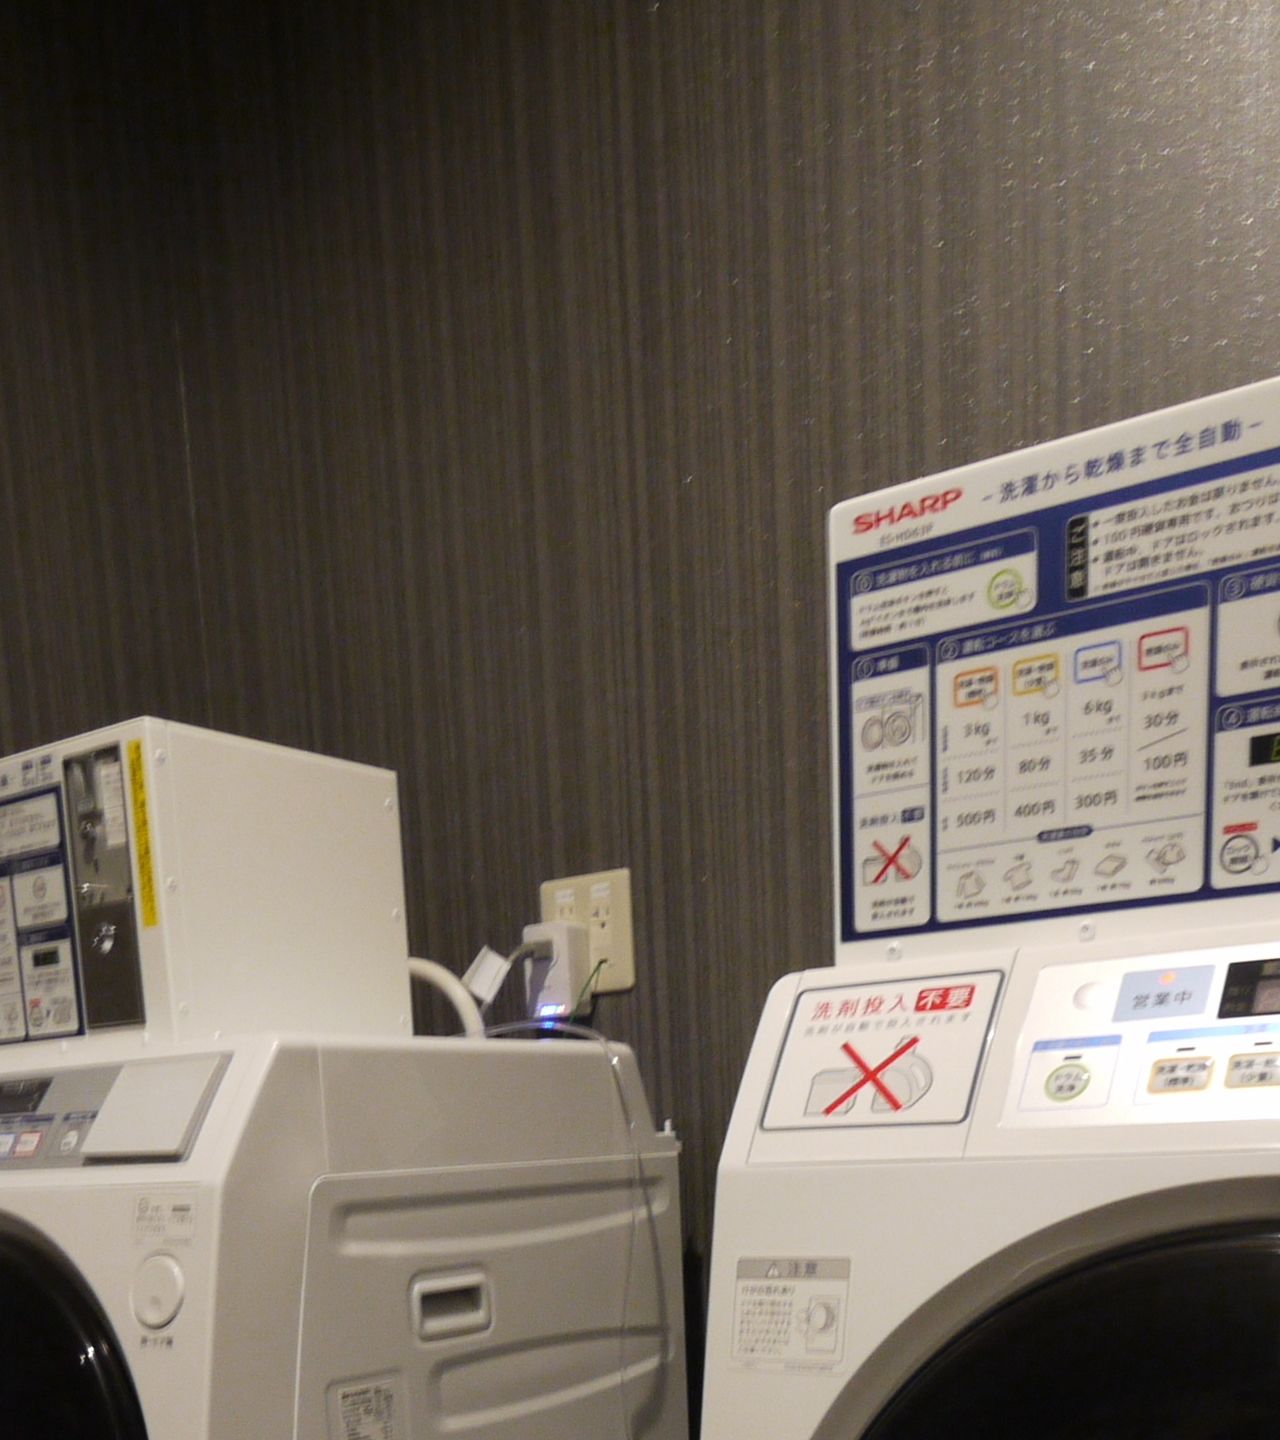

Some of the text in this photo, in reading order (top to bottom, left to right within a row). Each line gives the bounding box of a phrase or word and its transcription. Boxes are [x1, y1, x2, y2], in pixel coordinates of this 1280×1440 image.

[852, 487, 964, 535] SHARP
[812, 986, 974, 1021] 洗剤投入 不要
[1131, 990, 1193, 1011] 営業中
